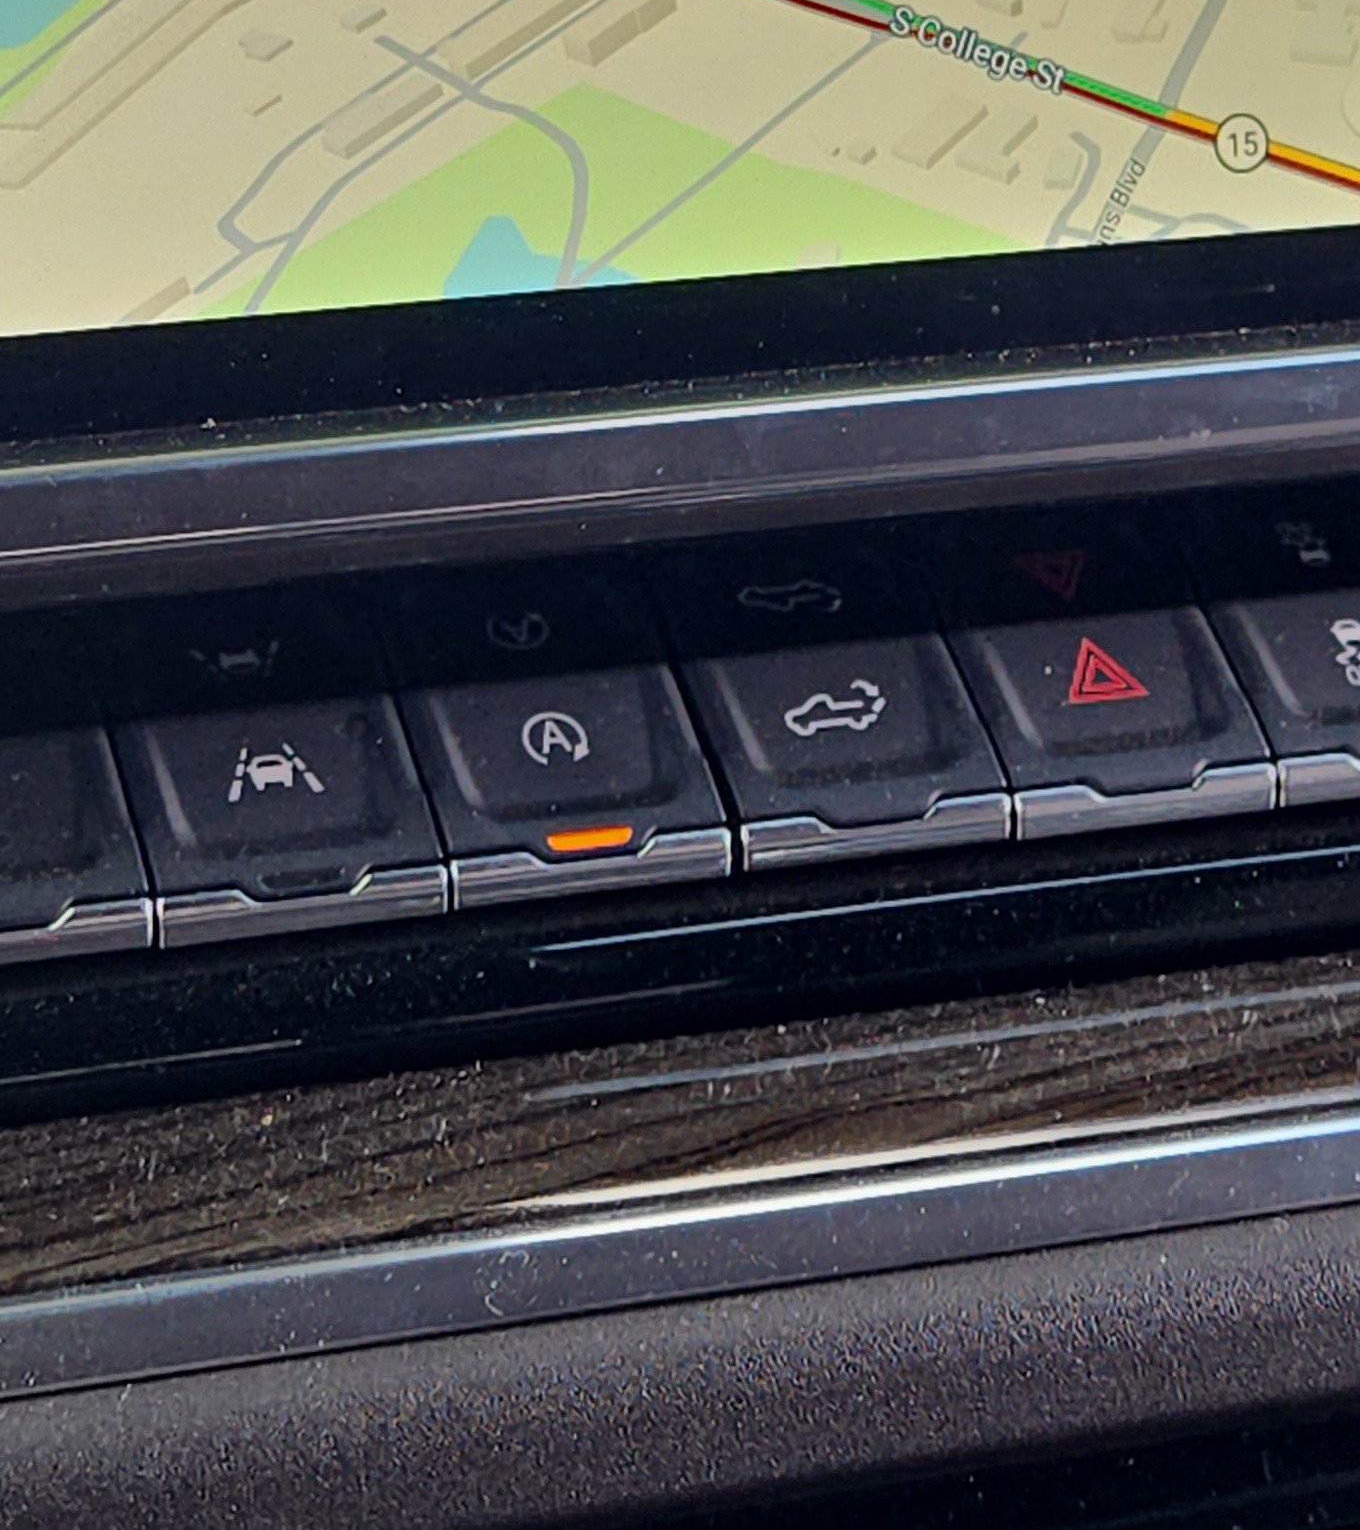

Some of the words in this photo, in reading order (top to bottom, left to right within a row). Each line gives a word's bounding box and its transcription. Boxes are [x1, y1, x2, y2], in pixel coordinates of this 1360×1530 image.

[890, 5, 914, 36] S
[916, 16, 1028, 78] College
[1033, 59, 1065, 94] St
[1227, 130, 1259, 158] 15
[1109, 156, 1146, 208] Blvd
